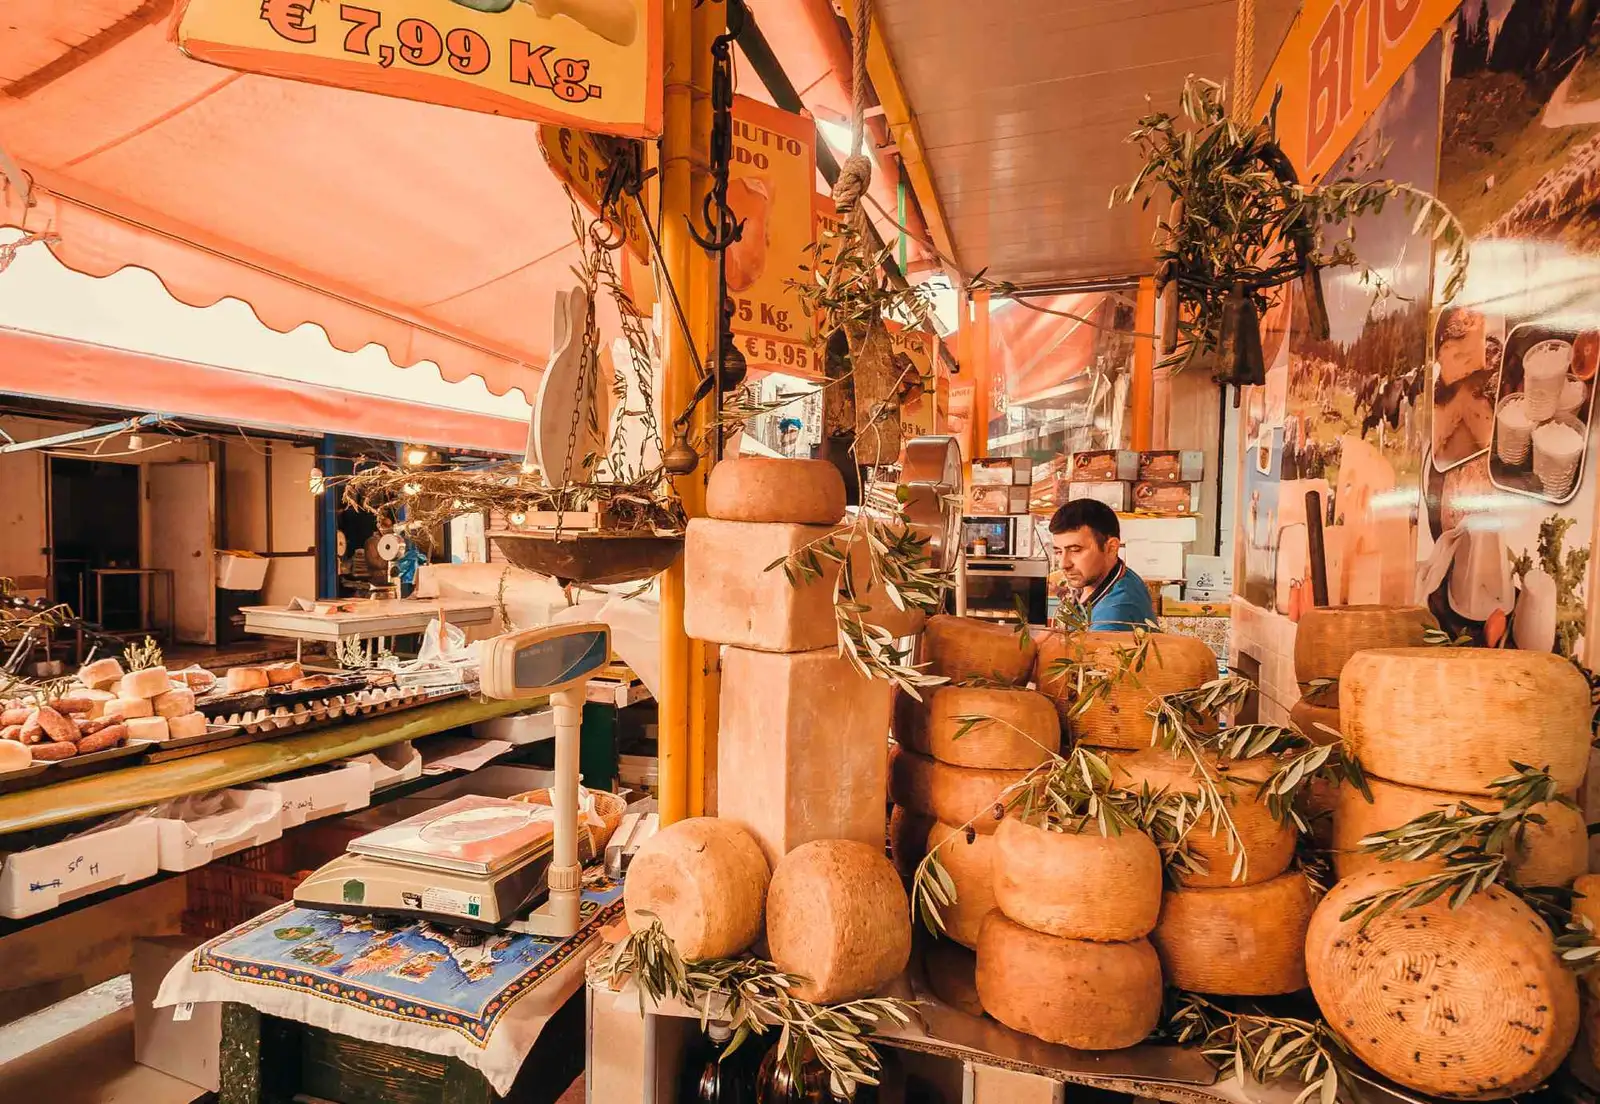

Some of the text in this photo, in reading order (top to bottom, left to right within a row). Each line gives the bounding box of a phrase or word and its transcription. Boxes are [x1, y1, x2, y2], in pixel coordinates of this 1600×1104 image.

[259, 0, 602, 103] € 7,99 Kg.
[559, 127, 573, 165] €
[760, 302, 793, 333] Kg.
[745, 337, 759, 357] €
[764, 340, 808, 369] 5,95
